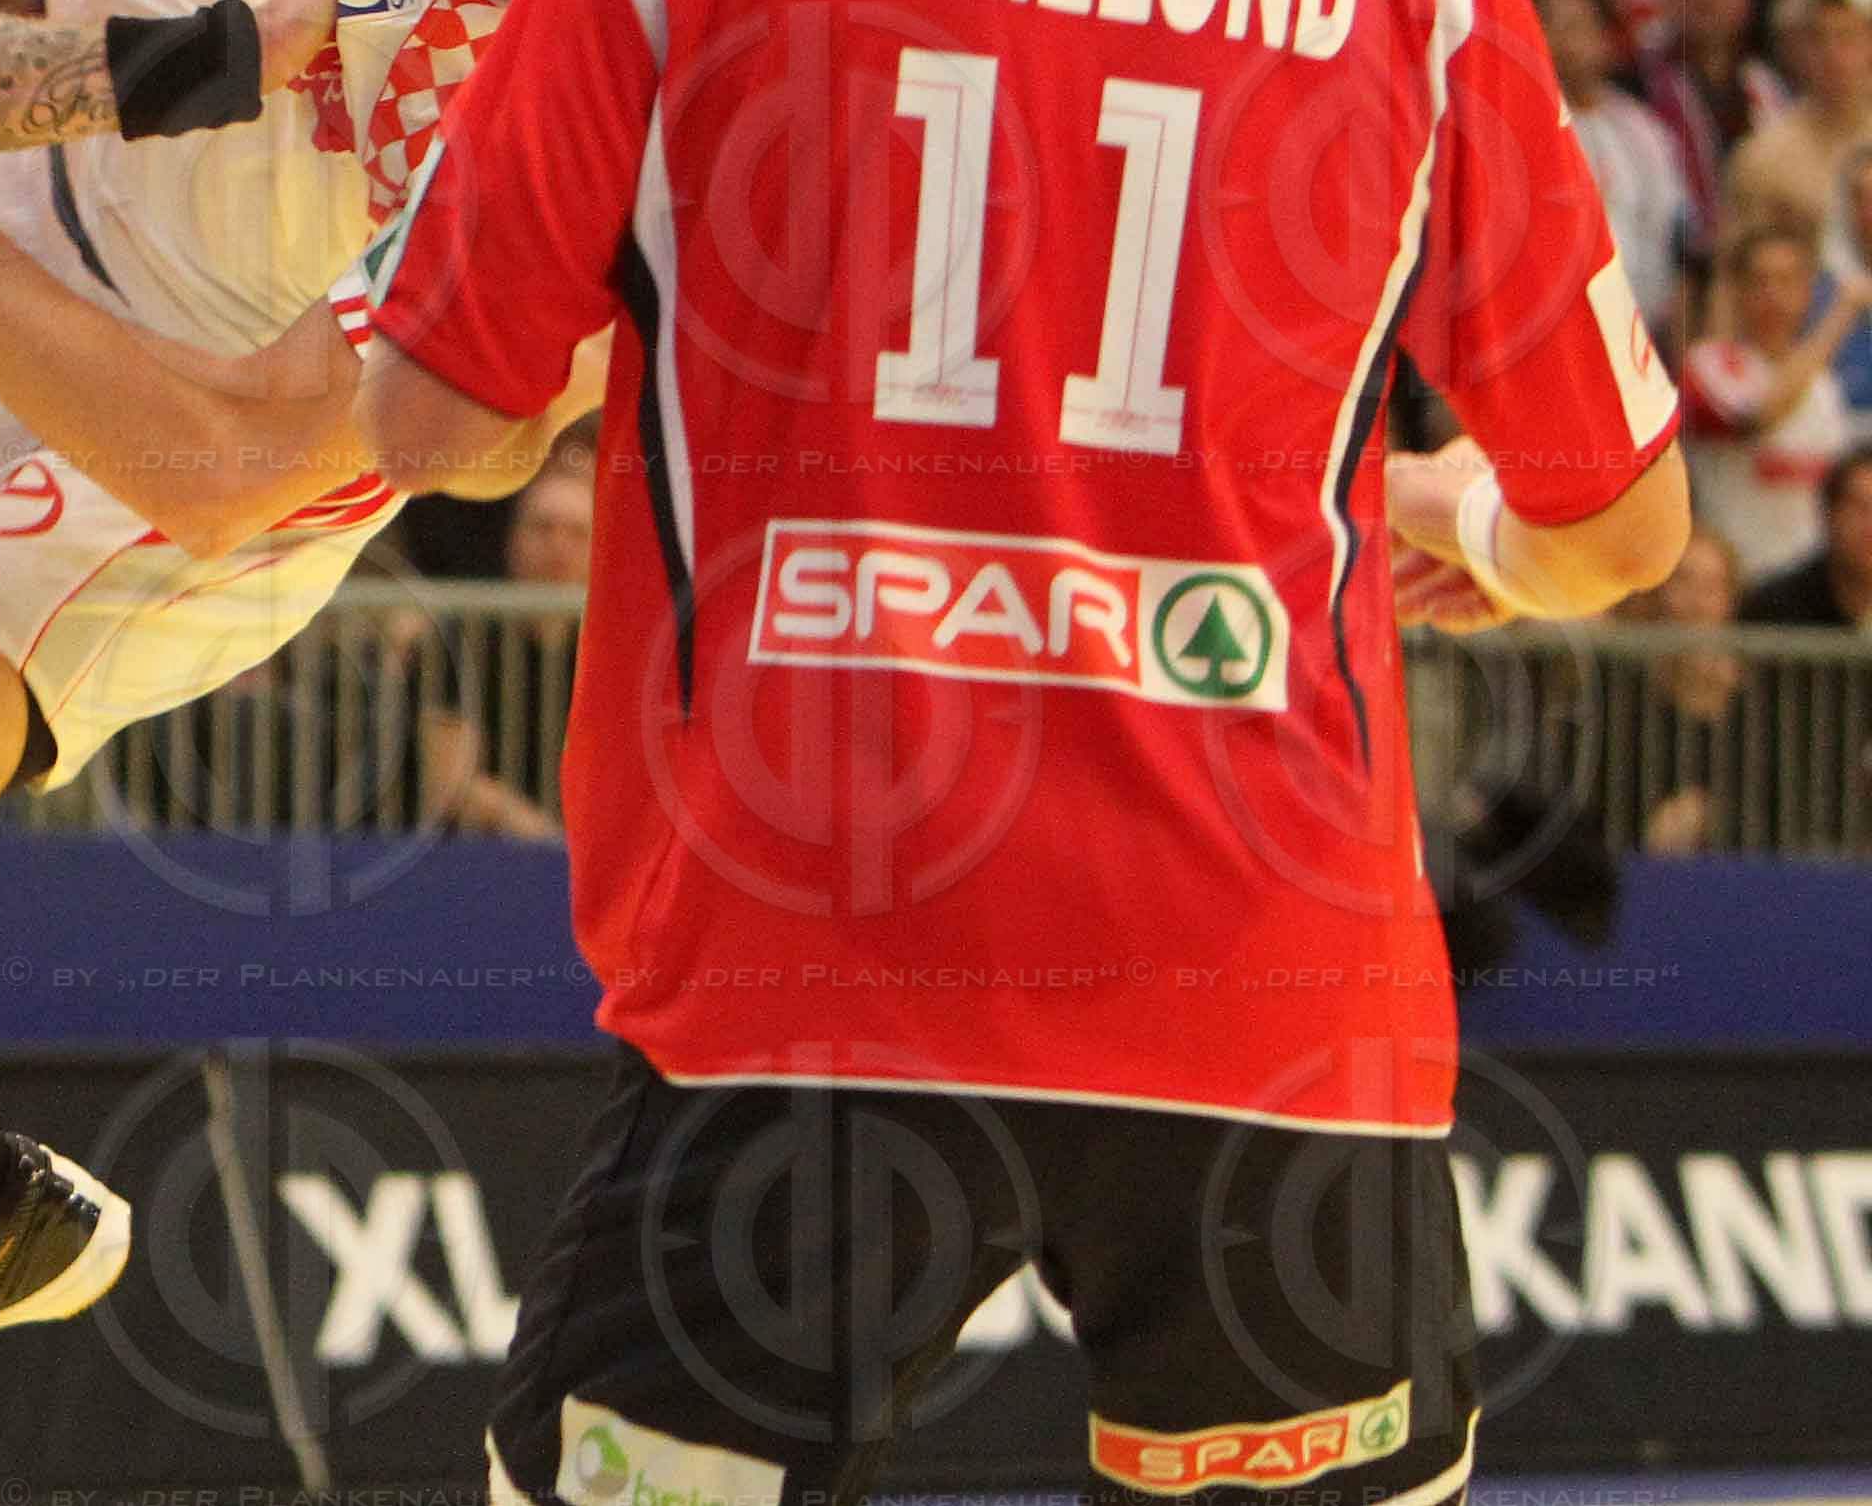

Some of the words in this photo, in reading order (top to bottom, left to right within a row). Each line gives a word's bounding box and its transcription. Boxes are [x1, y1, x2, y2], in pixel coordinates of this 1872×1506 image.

[873, 47, 1204, 457] 11
[773, 547, 1133, 669] SPAR
[277, 1170, 521, 1363] XL
[1138, 1422, 1345, 1482] SPAR
